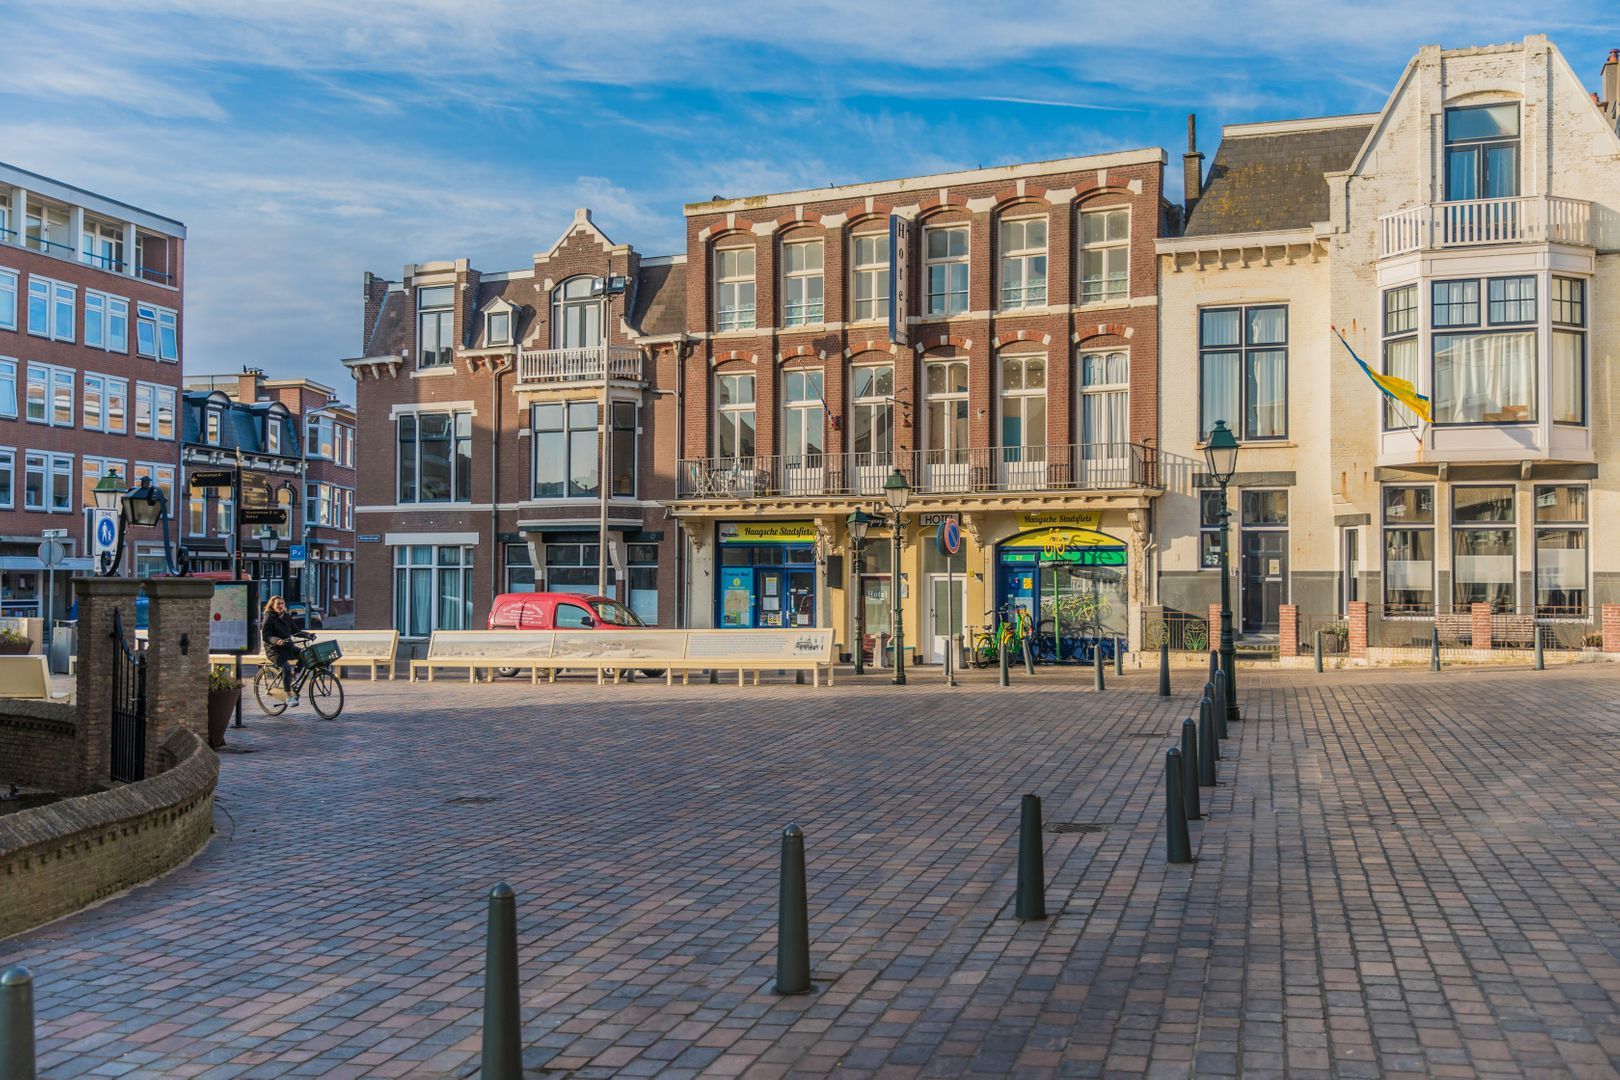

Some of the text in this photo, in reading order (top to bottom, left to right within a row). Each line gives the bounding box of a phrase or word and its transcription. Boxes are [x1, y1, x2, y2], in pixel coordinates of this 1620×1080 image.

[1024, 514, 1092, 525] Haagsche Stadsfiets
[744, 527, 778, 538] Haagsche
[867, 591, 888, 599] Hotel
